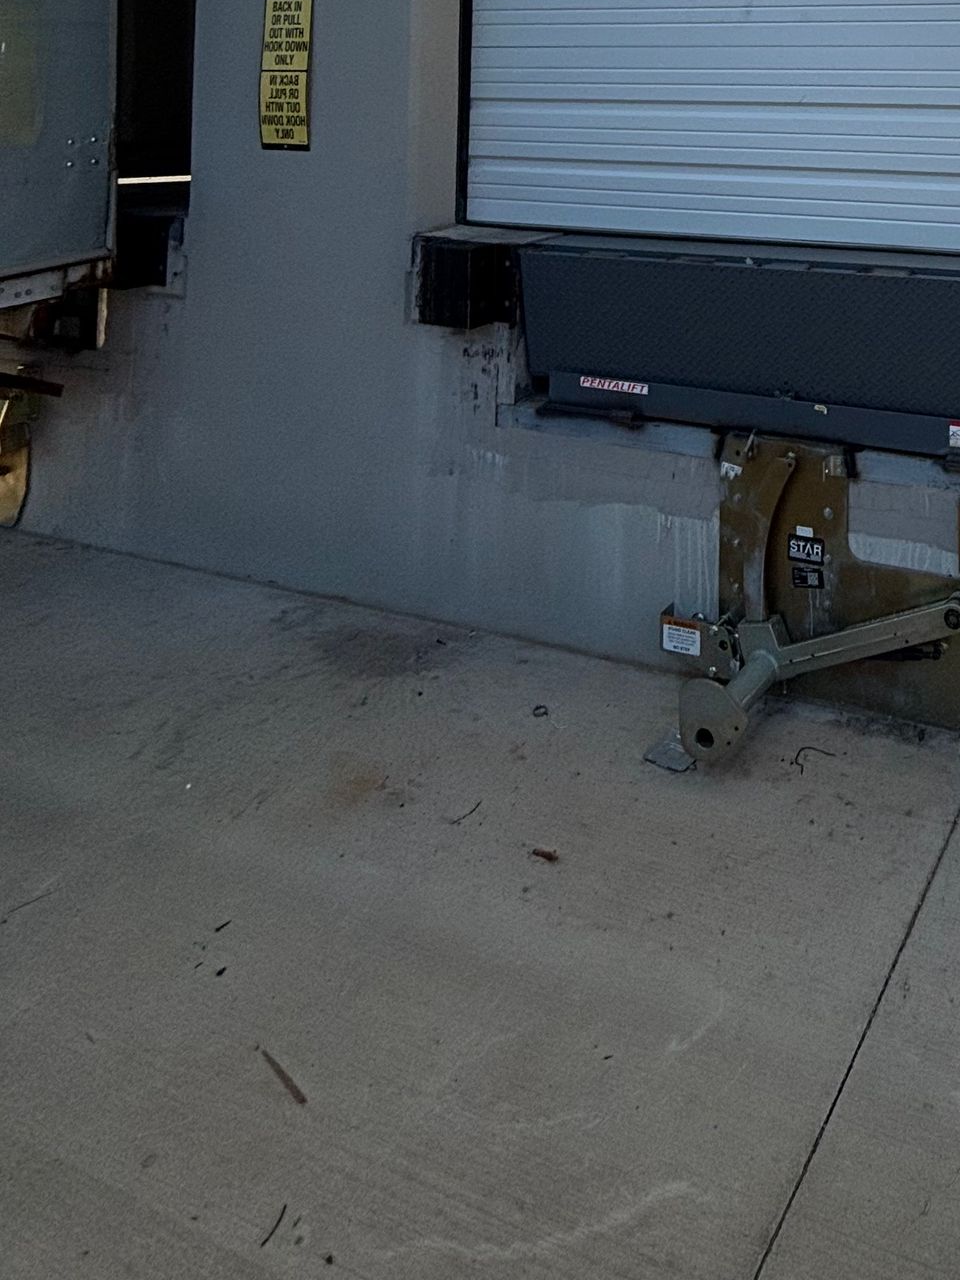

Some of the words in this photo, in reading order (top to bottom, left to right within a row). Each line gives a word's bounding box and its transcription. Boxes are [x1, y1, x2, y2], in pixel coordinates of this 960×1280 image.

[272, 1, 292, 12] BACK
[294, 1, 302, 12] IN
[271, 14, 282, 25] OR
[282, 14, 302, 25] PULL
[269, 27, 283, 39] OUT
[284, 27, 304, 39] WITH
[264, 41, 283, 52] HOOK
[284, 41, 308, 52] DOWN
[274, 54, 295, 66] ONLY
[582, 377, 646, 393] PENTALIFT
[790, 539, 822, 556] STAR
